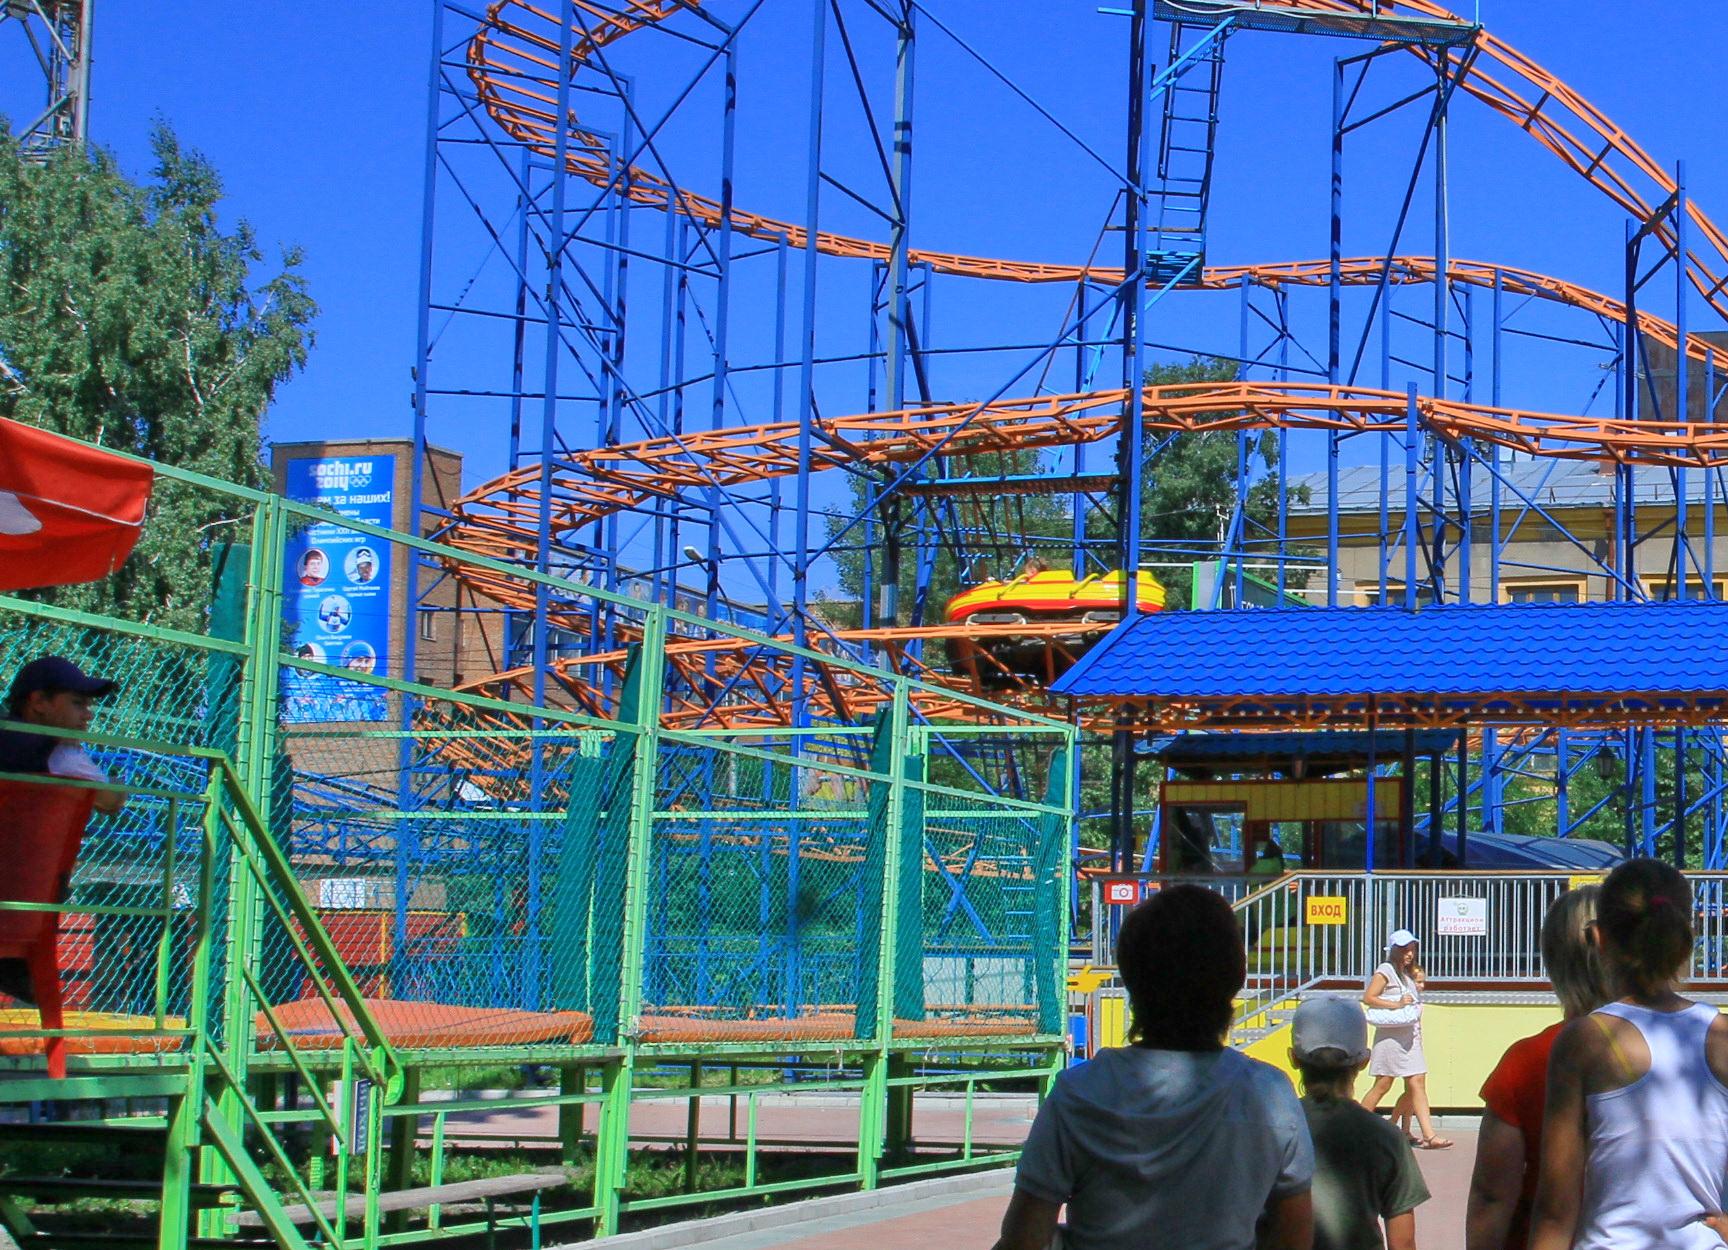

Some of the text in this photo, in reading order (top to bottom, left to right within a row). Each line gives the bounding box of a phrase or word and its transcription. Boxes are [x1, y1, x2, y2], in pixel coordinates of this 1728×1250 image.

[309, 461, 373, 477] sochi.ru
[316, 476, 349, 491] 2014
[333, 495, 346, 505] за
[350, 491, 390, 504] наших!
[1311, 904, 1341, 918] ВХОД
